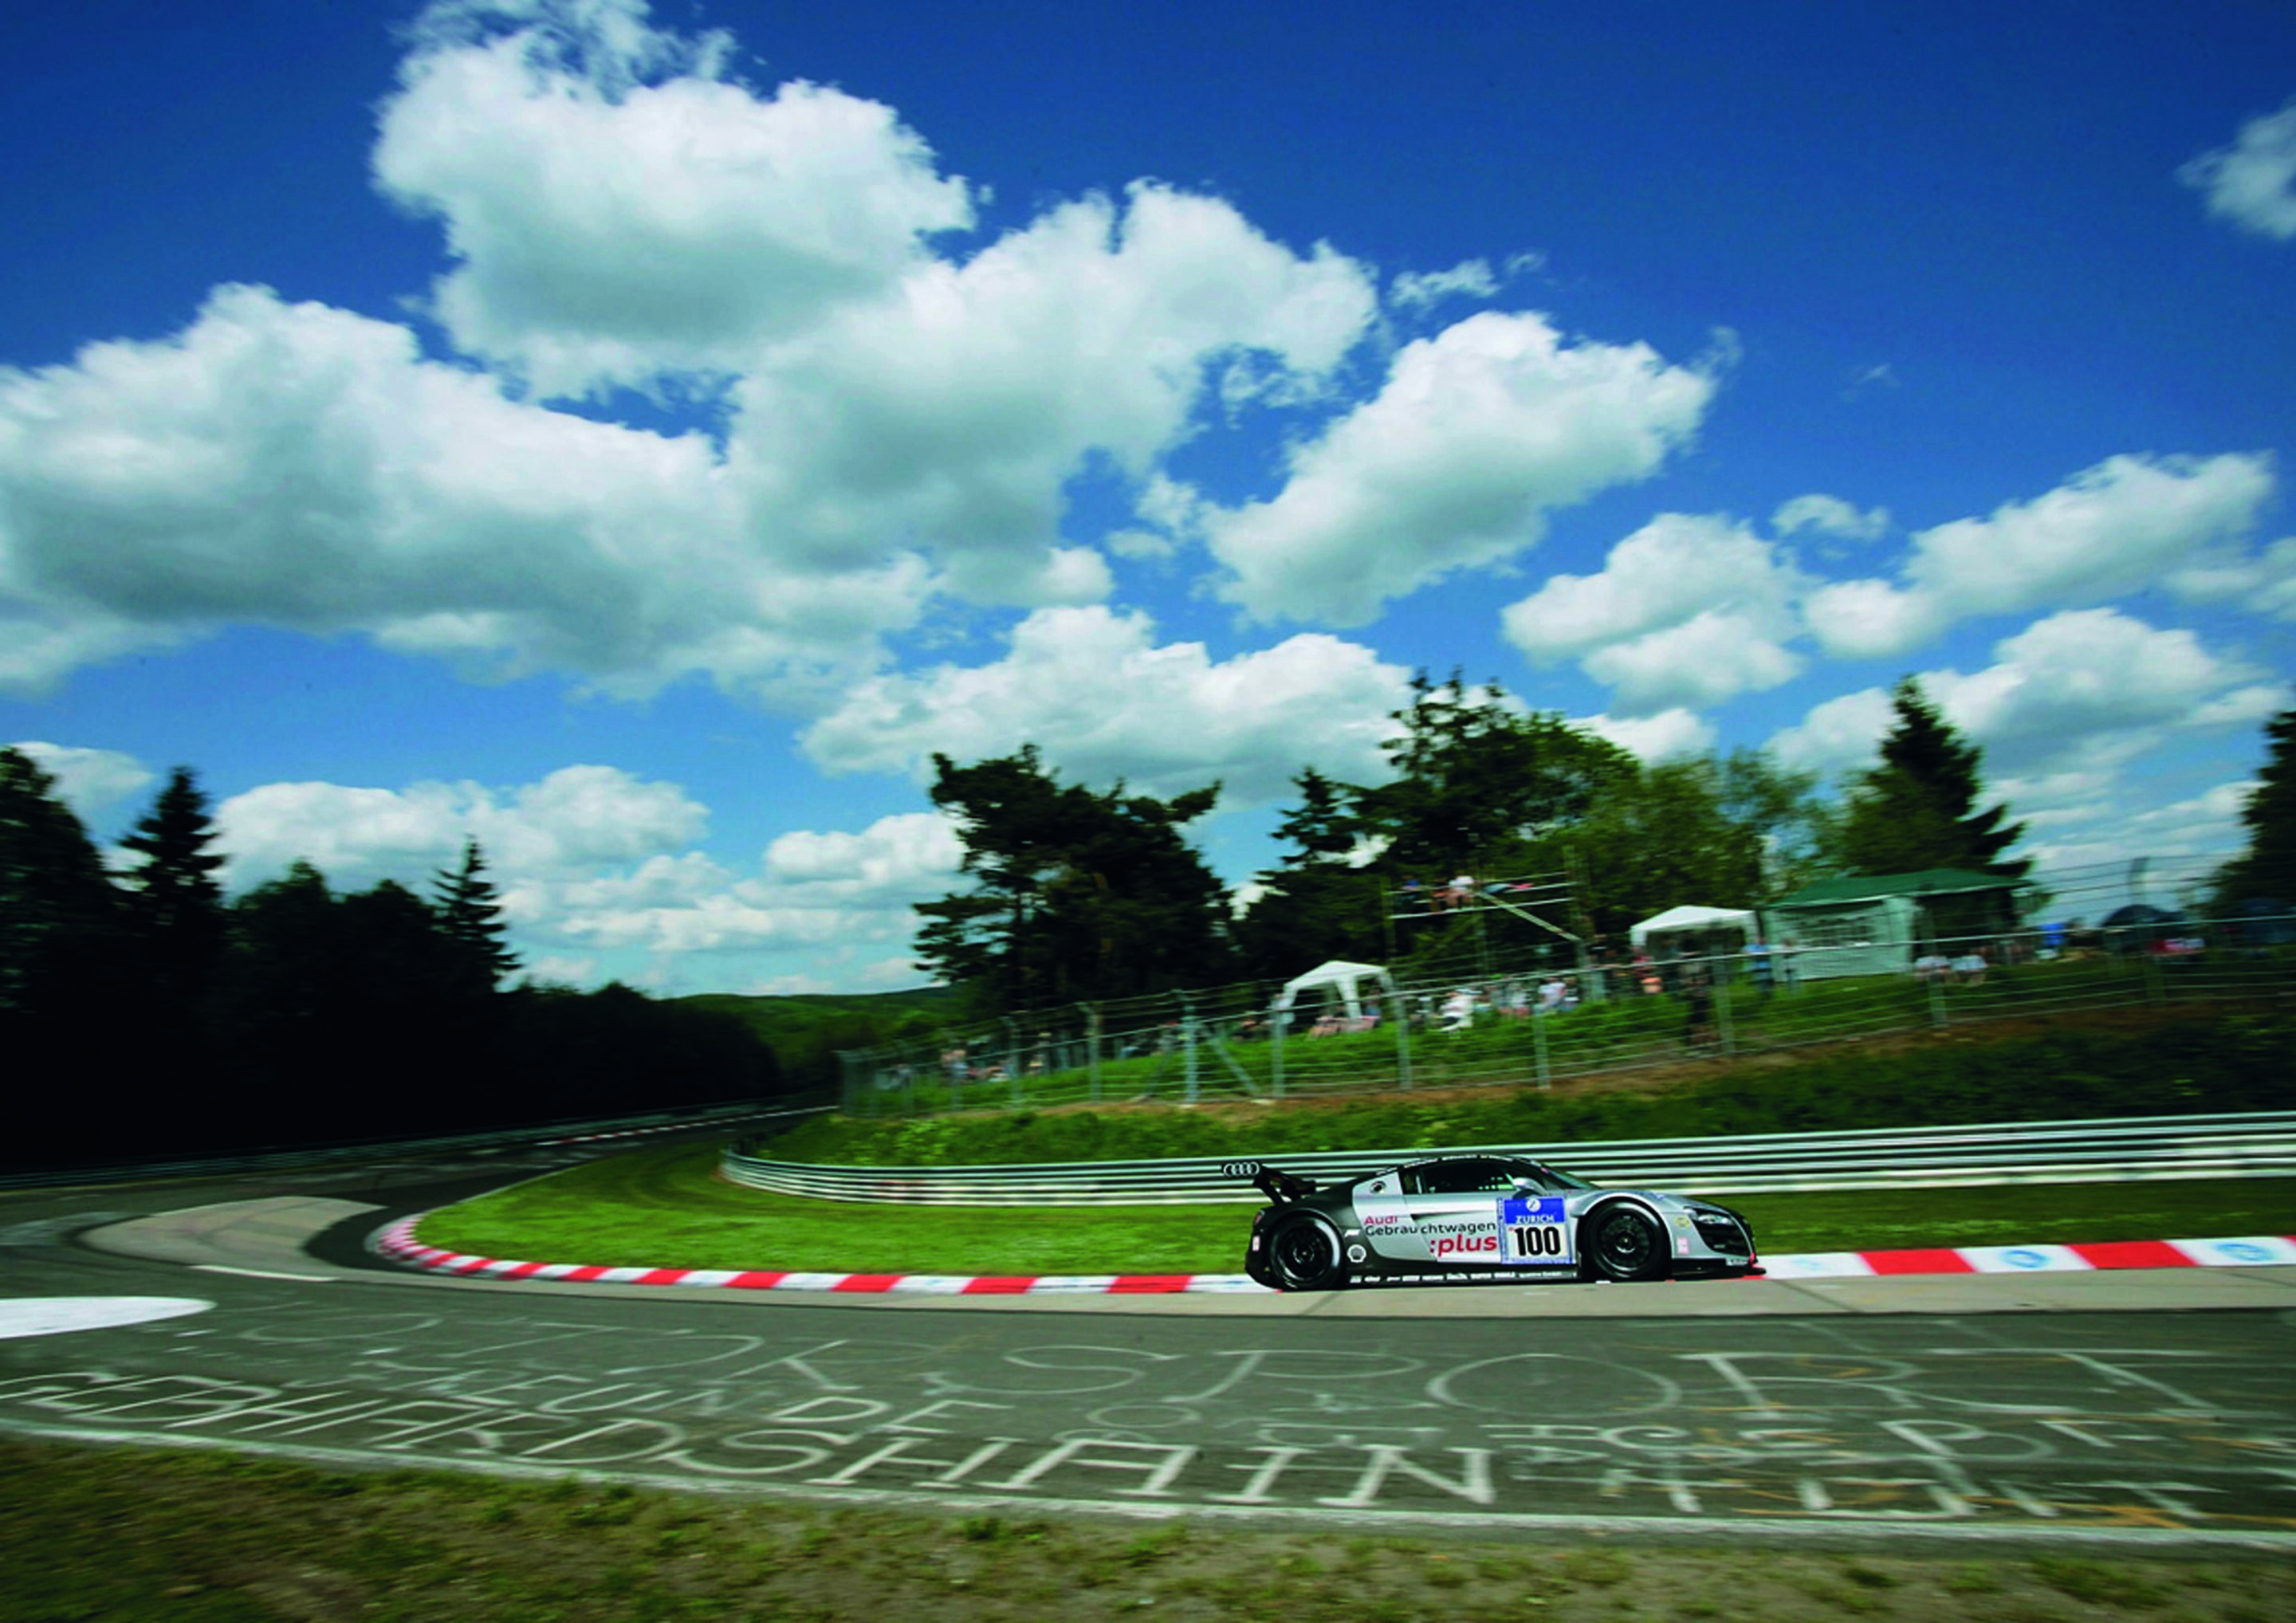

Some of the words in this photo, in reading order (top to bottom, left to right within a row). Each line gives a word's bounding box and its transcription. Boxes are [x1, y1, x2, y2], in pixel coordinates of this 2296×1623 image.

[1364, 1215, 1398, 1225] Audi
[1516, 1214, 1555, 1224] ZURICH
[1365, 1221, 1496, 1236] Gebrauchtwagen
[1515, 1226, 1561, 1256] 100
